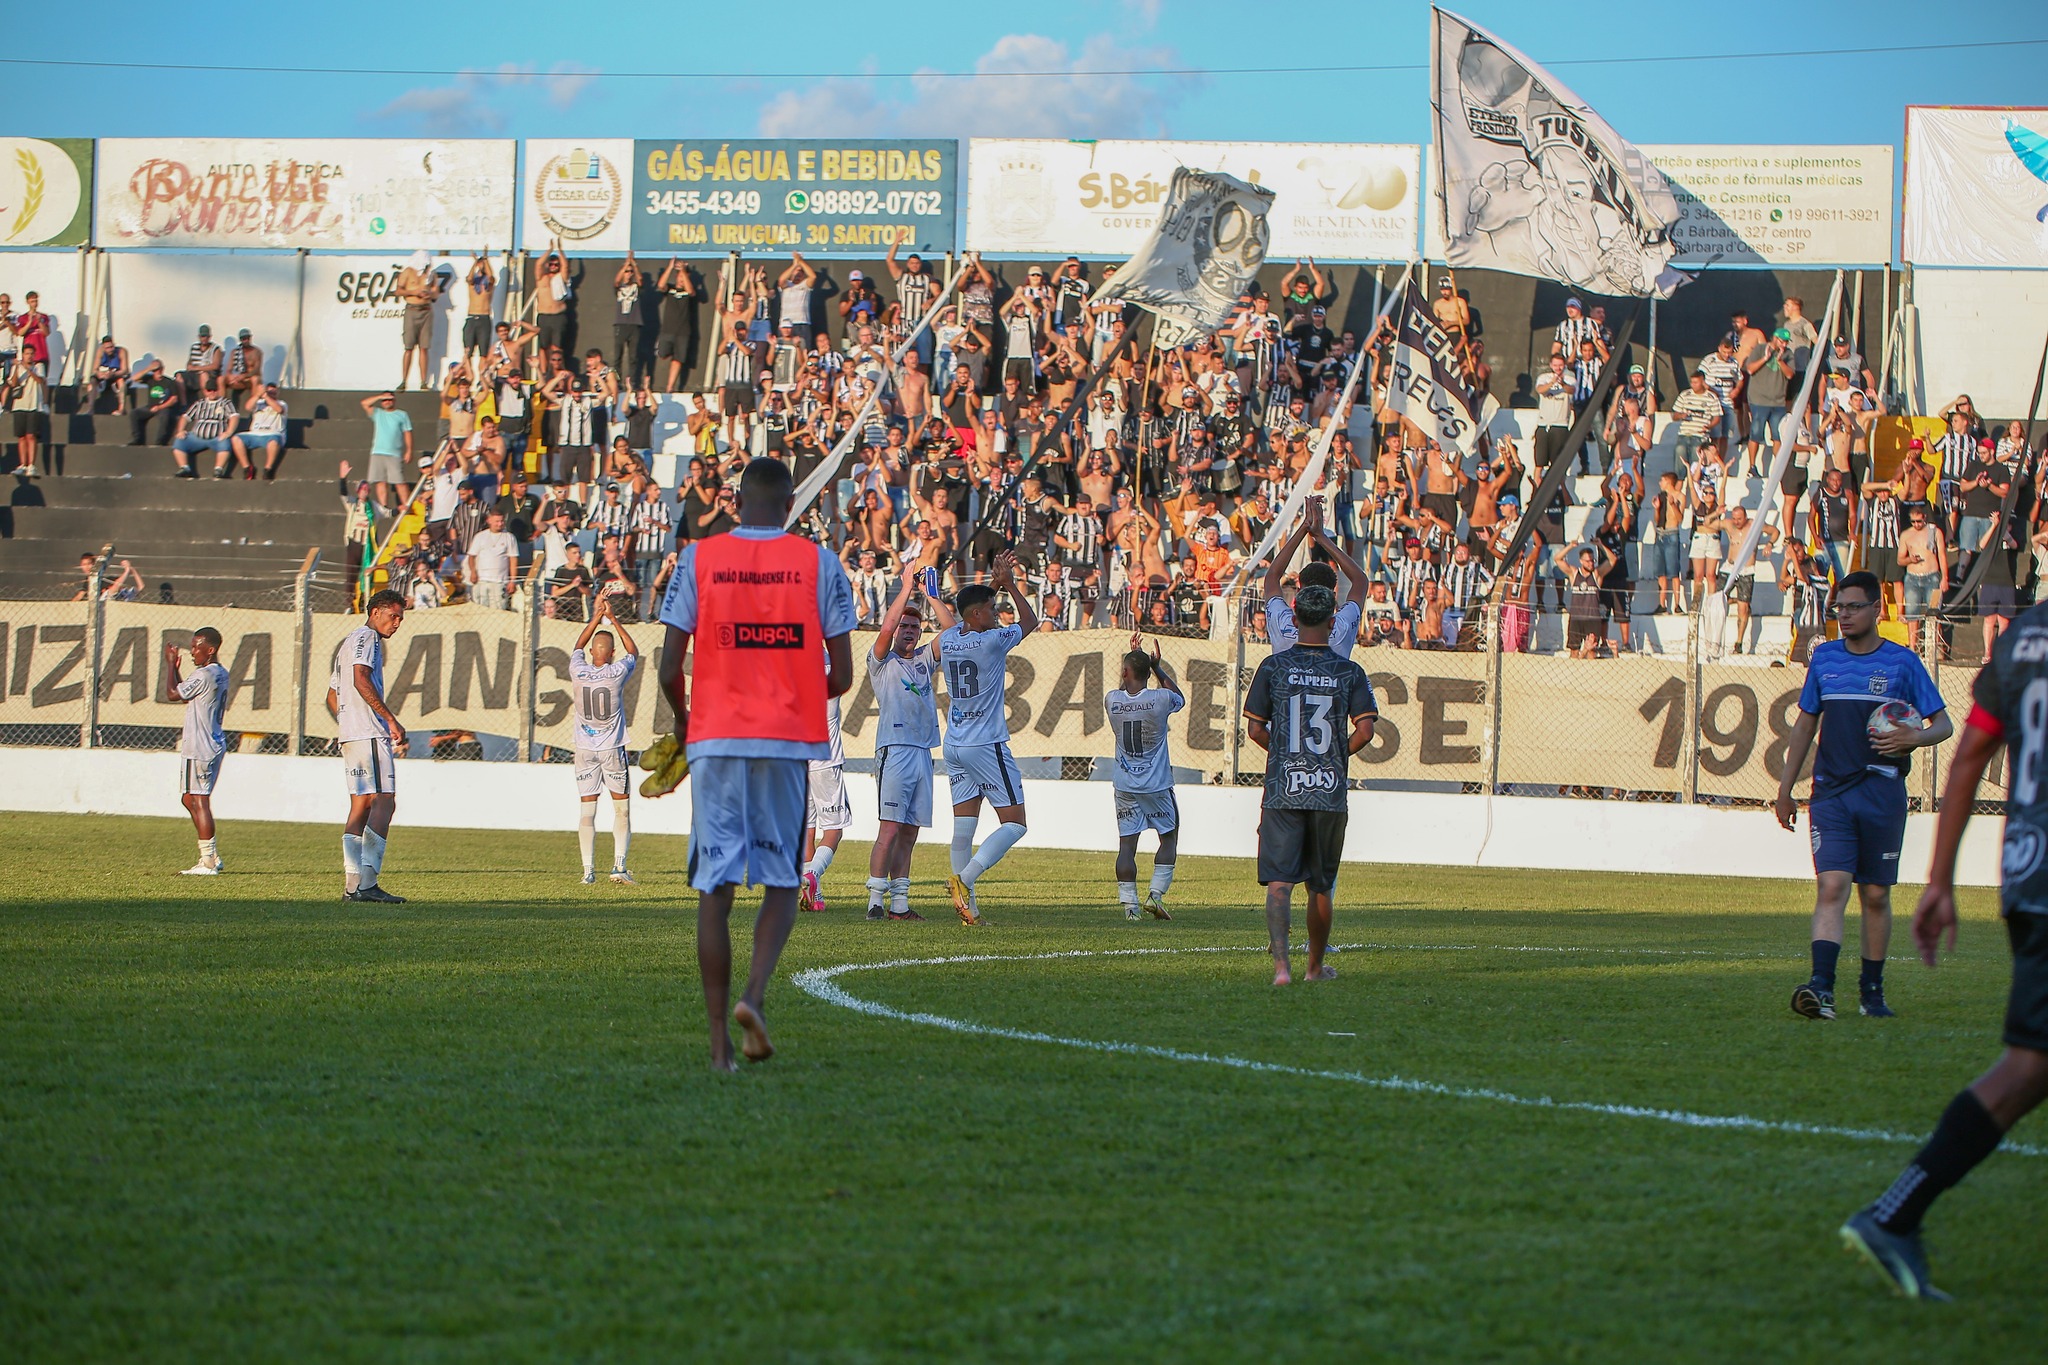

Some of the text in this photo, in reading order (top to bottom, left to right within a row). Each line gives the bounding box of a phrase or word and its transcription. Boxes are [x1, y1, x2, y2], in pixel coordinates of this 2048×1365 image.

[647, 143, 942, 181] GÁS-ÁGUA E BEBIDAS
[1651, 156, 1862, 170] trição esportiva e suplementos
[1724, 174, 1739, 185] de
[1744, 173, 1803, 185] fórmulas
[1806, 173, 1863, 185] médicas
[547, 187, 610, 201] CÉSAR GÁS
[646, 190, 942, 215] 3455-4349 98892-0762
[1674, 191, 1791, 205] rapia e Cosmética
[1695, 208, 1762, 221] 3455-1216
[1787, 208, 1803, 221] 19
[1806, 208, 1880, 221] 99611-3921
[669, 223, 708, 244] RUA
[806, 224, 830, 244] 30
[833, 223, 916, 245] SARTORI
[1745, 226, 1768, 238] 327
[1772, 227, 1812, 238] centro
[1726, 240, 1774, 253] d'Oeste
[1786, 241, 1806, 254] SP
[337, 264, 403, 308] SEÇÃ
[713, 568, 737, 584] UNIÃO
[738, 571, 785, 585] BARBARENSE
[738, 627, 799, 645] DUBAL
[949, 640, 982, 652] AQUALLY
[0, 621, 272, 710] IZADA
[948, 659, 980, 699] 13
[1287, 674, 1338, 688] CAPREM
[582, 686, 612, 721] 10
[1119, 702, 1156, 713] AQUALLY
[1289, 693, 1334, 755] 13
[1122, 720, 1144, 758] 11
[2014, 677, 2048, 806] 8
[1289, 768, 1335, 793] Poty
